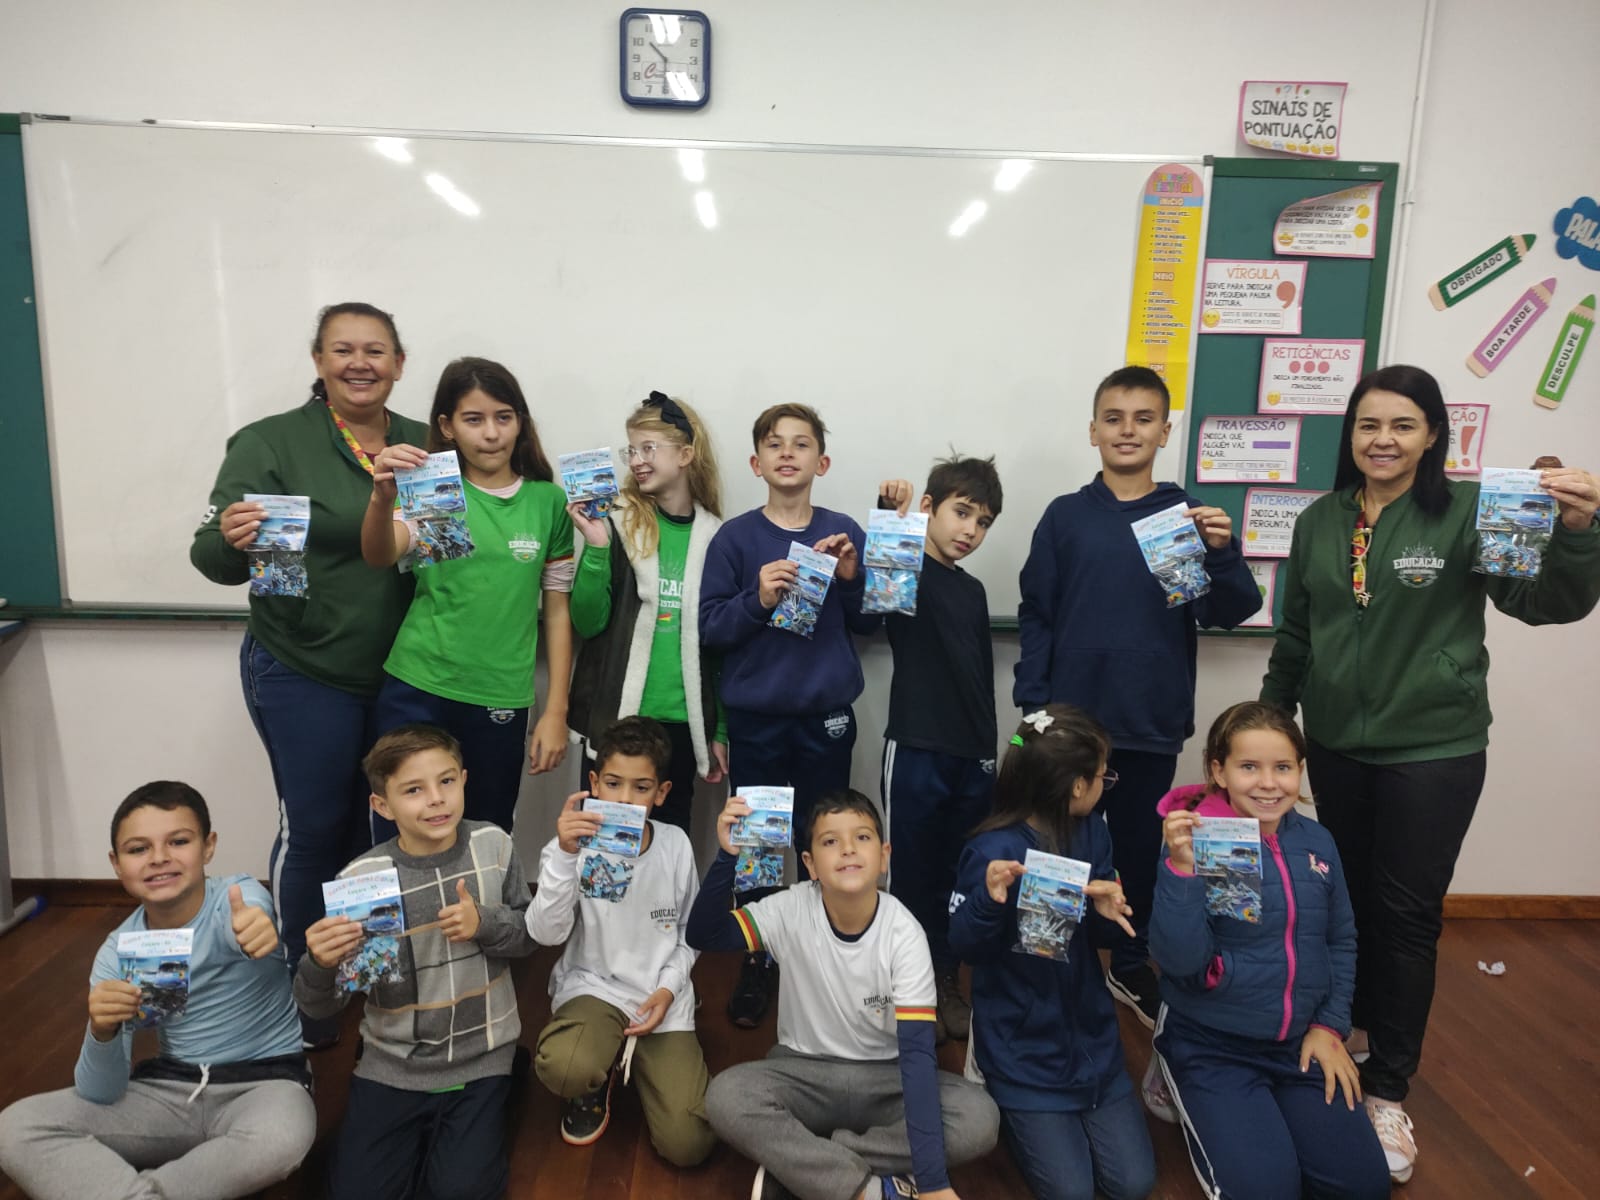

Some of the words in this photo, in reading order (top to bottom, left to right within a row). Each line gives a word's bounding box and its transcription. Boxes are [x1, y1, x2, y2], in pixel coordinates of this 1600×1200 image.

[632, 37, 644, 46] 10
[690, 38, 699, 48] 2
[632, 54, 641, 63] 9
[689, 56, 698, 66] 3
[632, 71, 641, 81] 8
[645, 84, 653, 94] 7
[1251, 100, 1308, 117] SINAIS
[1313, 101, 1332, 118] DE
[1244, 118, 1337, 144] PONTUAÇÃO
[1564, 212, 1600, 251] PAL
[1226, 264, 1280, 280] VÍRGULA
[1450, 252, 1503, 291] OBRIGADO
[1206, 282, 1225, 290] SERVE
[1227, 282, 1244, 290] PARA
[1246, 283, 1273, 291] INDICAR
[1220, 291, 1247, 299] PEQUENA
[1485, 337, 1505, 359] BOA
[1504, 303, 1533, 337] TARDE
[1272, 344, 1351, 360] RETICÊNCIAS
[1547, 332, 1579, 389] DESCULPE
[1450, 407, 1478, 426] ÇÃO
[1216, 418, 1286, 431] TRAVESSÃO
[1202, 440, 1230, 449] ALGUÉM
[1232, 441, 1246, 449] VAI
[1250, 509, 1279, 519] INDICA
[1281, 510, 1299, 519] UMA
[1249, 520, 1292, 529] PERGUNTA.
